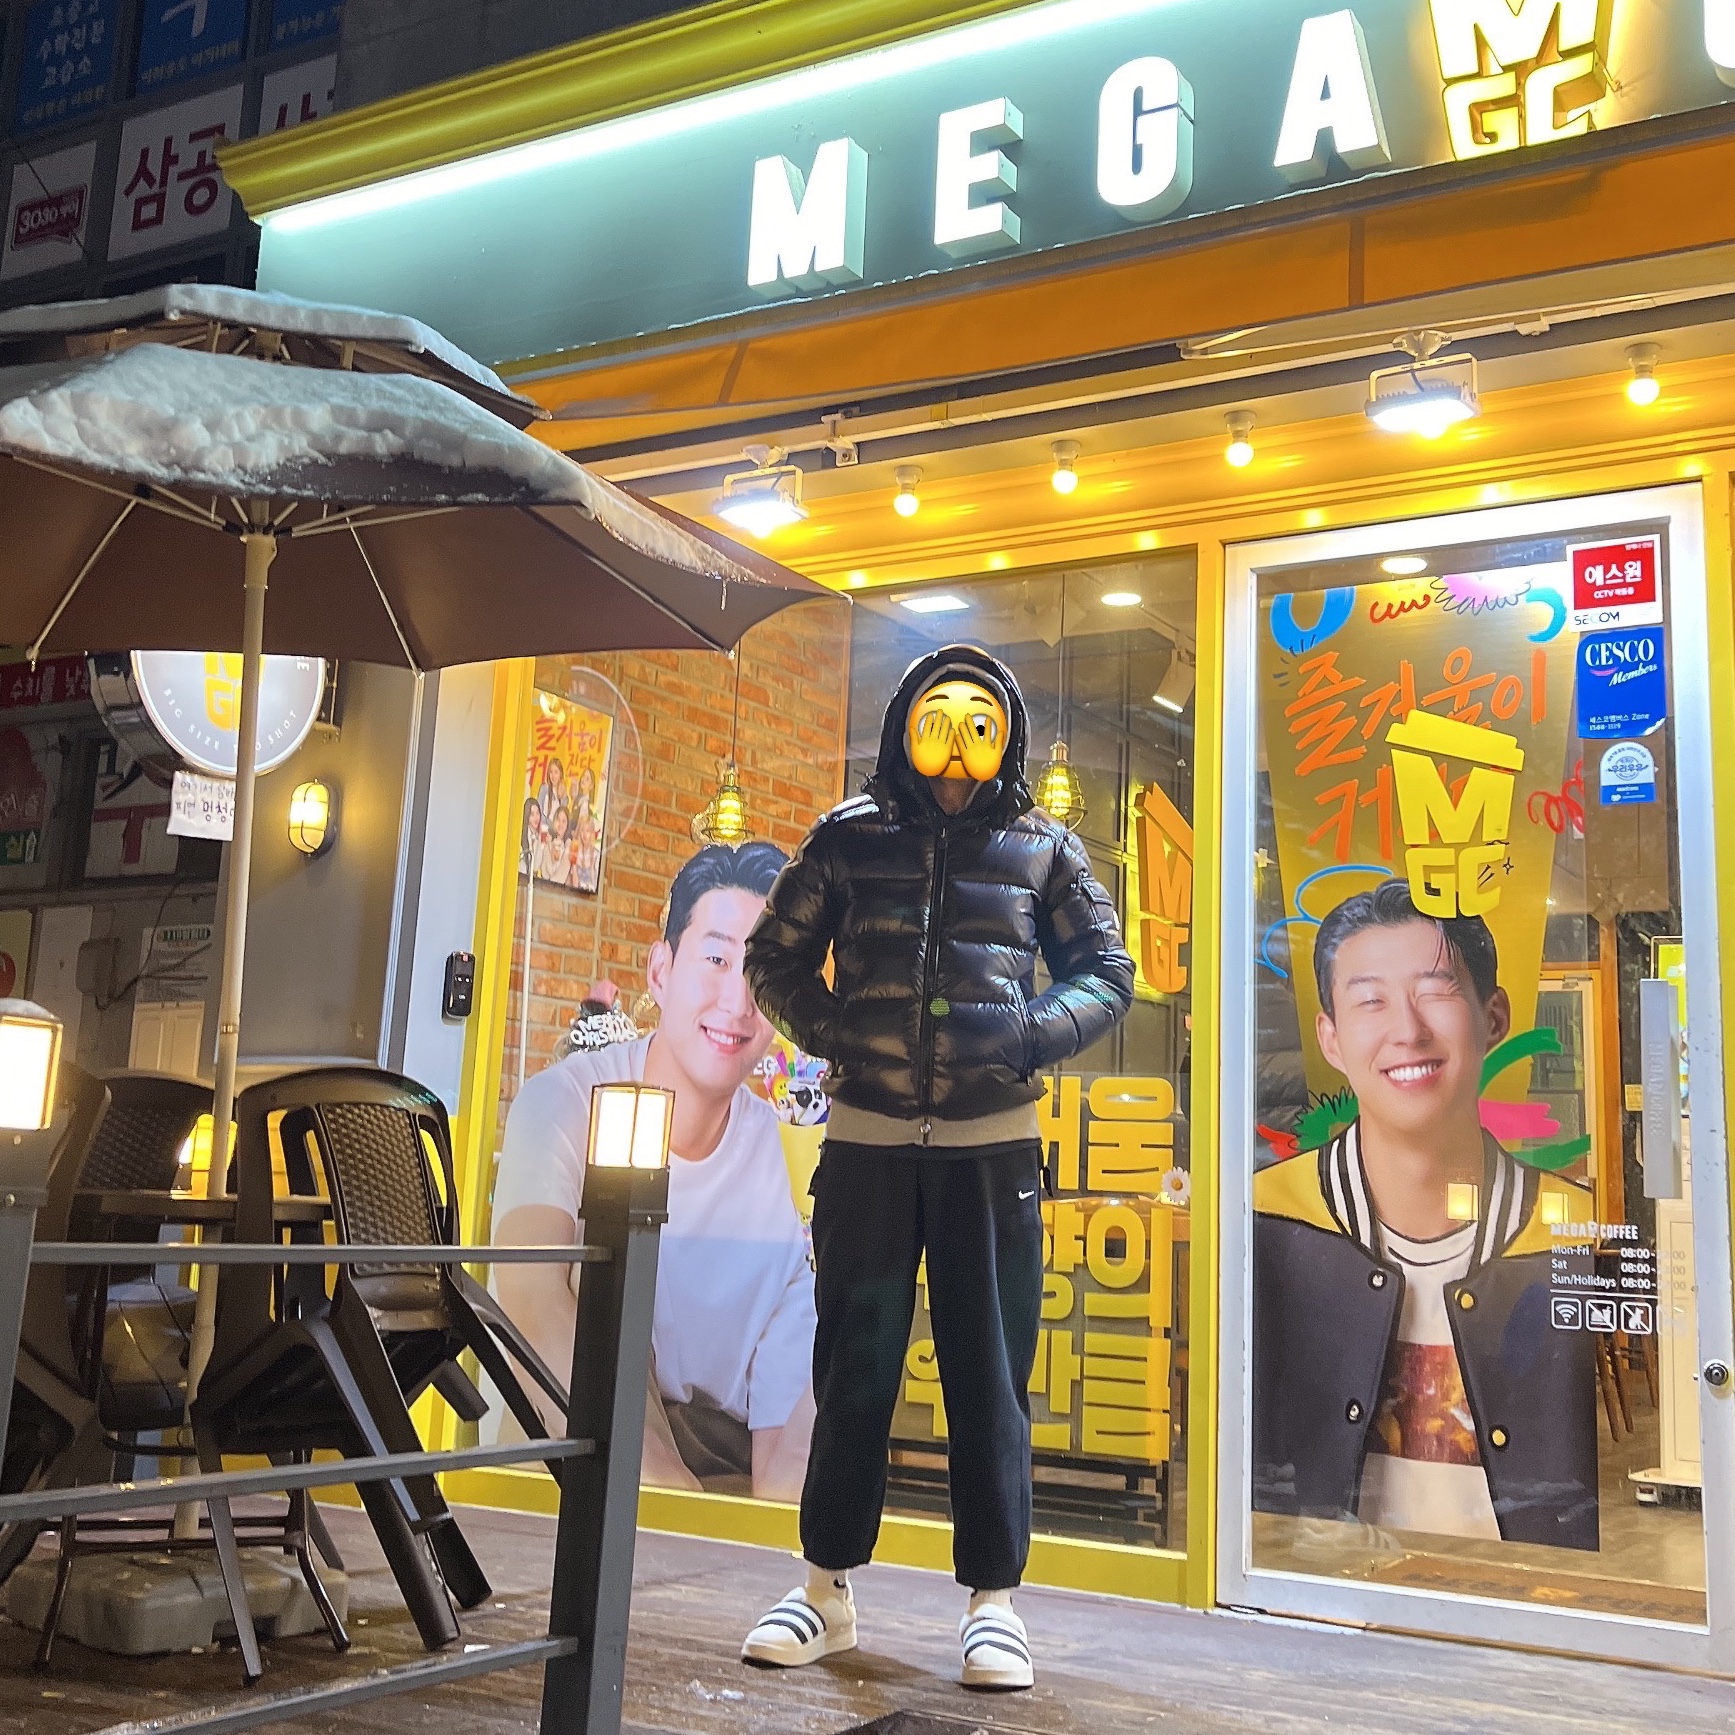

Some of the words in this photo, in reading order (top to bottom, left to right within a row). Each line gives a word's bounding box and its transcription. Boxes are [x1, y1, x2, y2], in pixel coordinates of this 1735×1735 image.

[747, 8, 1390, 296] MEGA
[123, 123, 226, 233] 삼공
[1584, 560, 1643, 587] 에스원
[1585, 638, 1655, 667] CESCO
[1609, 662, 1659, 687] Members
[1600, 1224, 1639, 1240] COFFEE
[1551, 1258, 1567, 1270] Sat
[1551, 1273, 1616, 1289] Sun/Holidays
